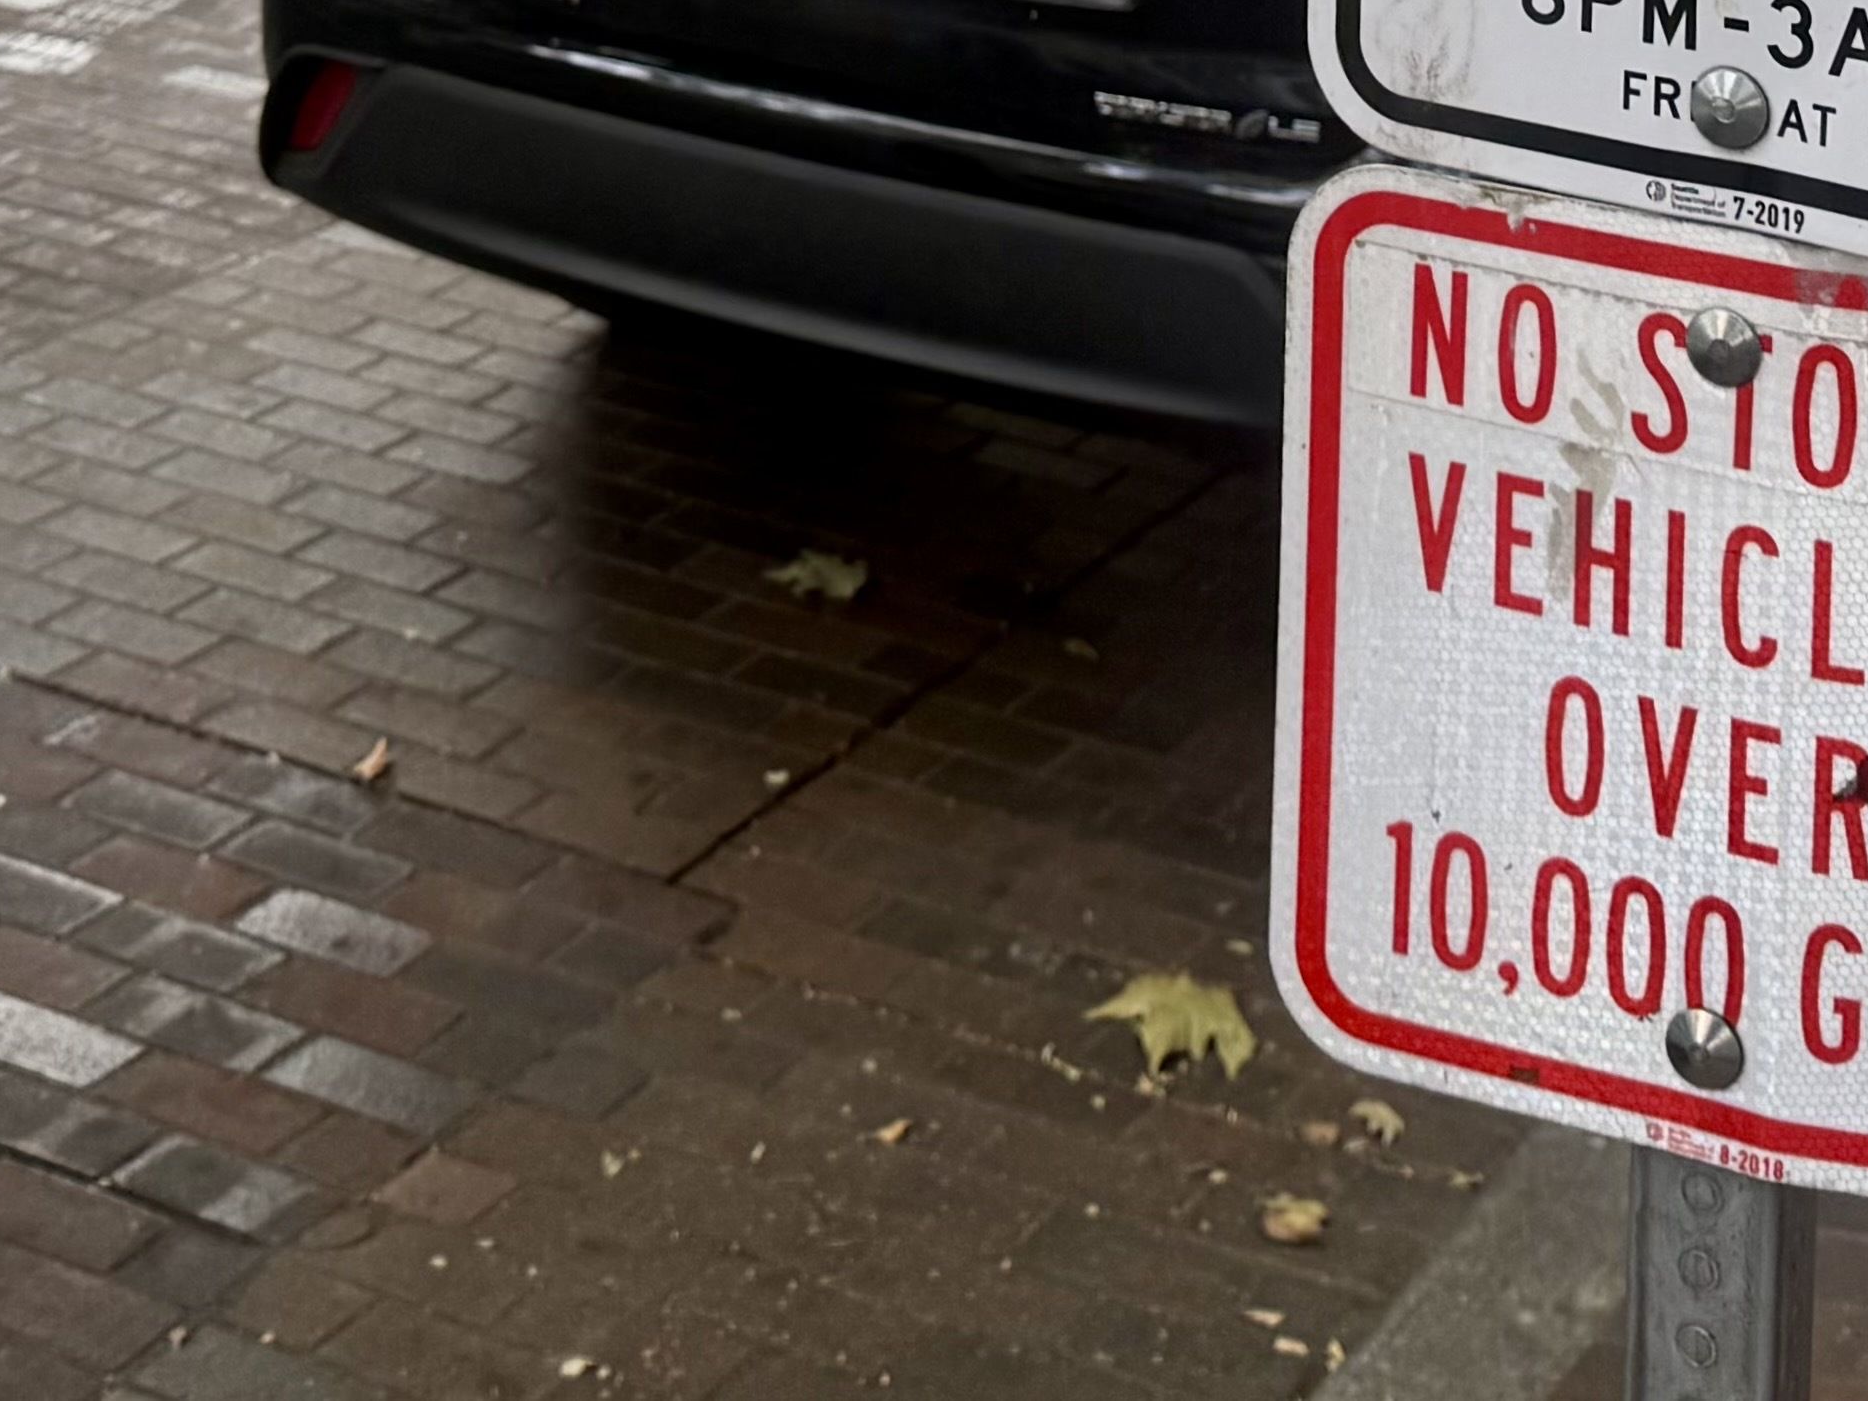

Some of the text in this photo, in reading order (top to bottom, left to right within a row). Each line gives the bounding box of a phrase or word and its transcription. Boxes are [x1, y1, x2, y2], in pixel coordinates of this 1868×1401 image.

[1733, 195, 1805, 235] 7-2019
[1409, 262, 1559, 425] NO
[1386, 819, 1746, 1018] 10,000
[1719, 1144, 1785, 1182] 8-2018
